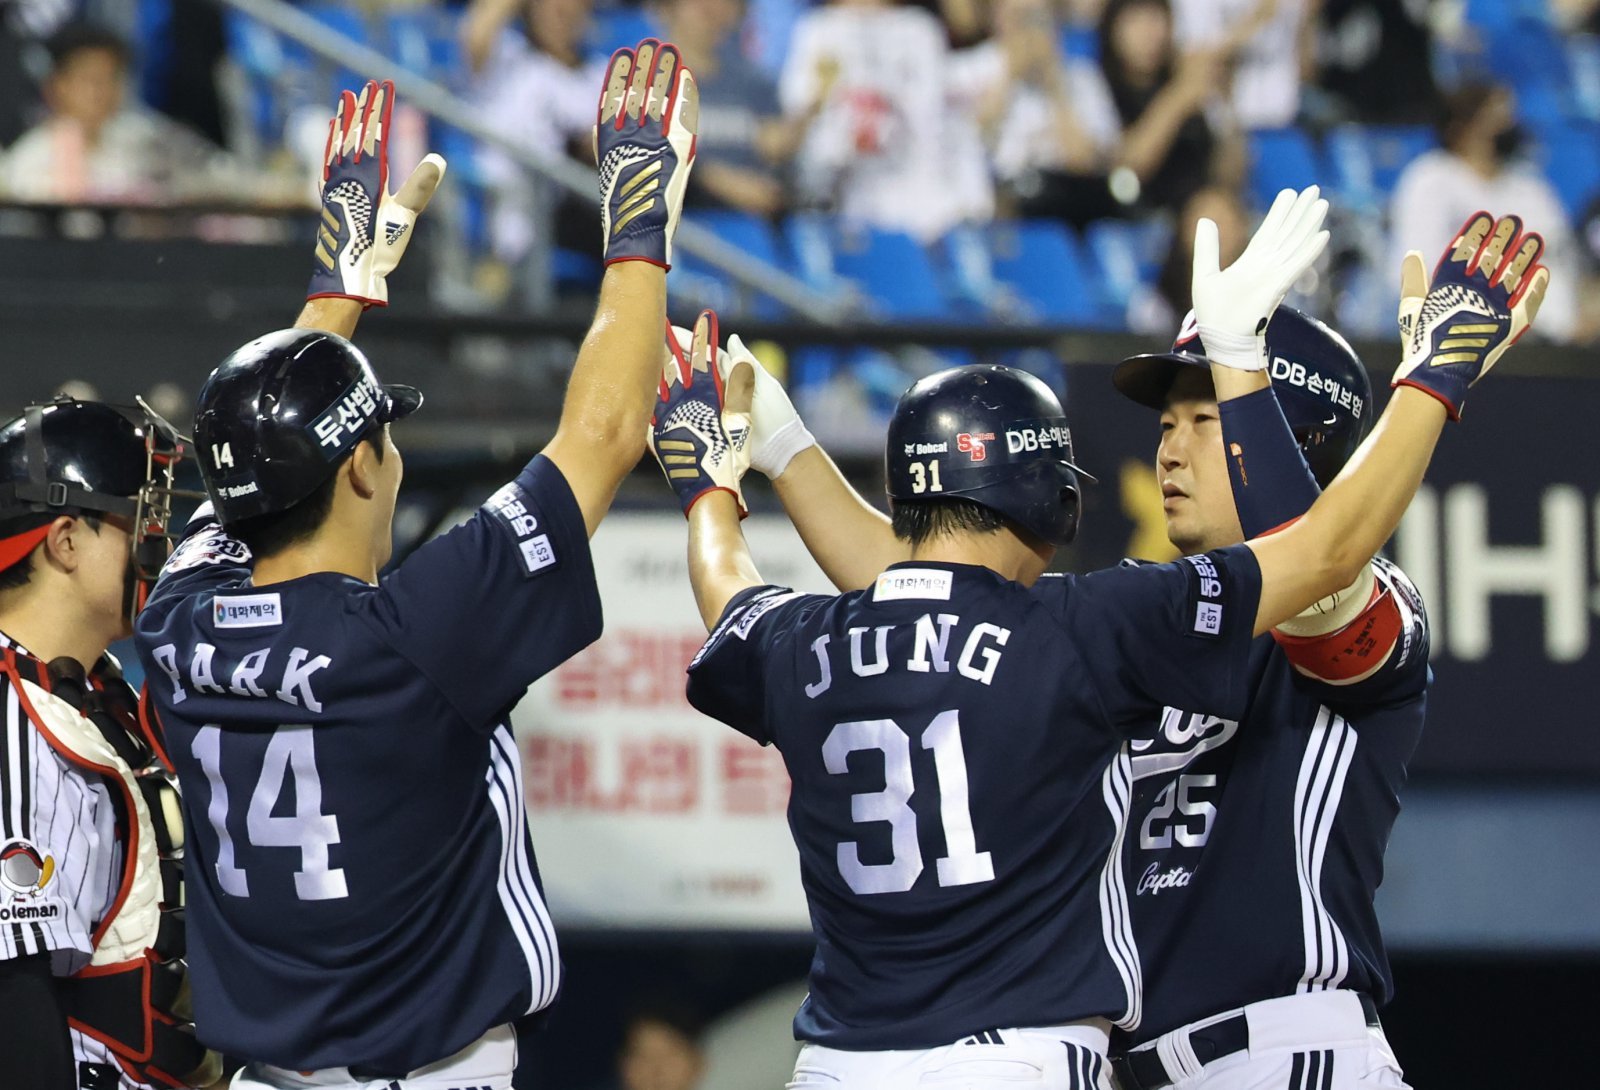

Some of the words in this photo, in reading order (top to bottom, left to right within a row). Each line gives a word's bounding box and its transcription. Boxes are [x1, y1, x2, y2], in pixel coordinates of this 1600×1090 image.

[386, 222, 409, 246] adidas
[1271, 357, 1364, 420] DB손해보험
[211, 441, 235, 470] 14
[916, 440, 950, 455] Bobcat
[1006, 427, 1073, 455] DB손해보
[228, 481, 259, 498] Bobcat
[909, 460, 942, 493] 31
[533, 541, 551, 563] EST
[227, 603, 276, 619] 대화제약
[1206, 607, 1218, 630] EST
[805, 614, 1012, 699] JUNG
[151, 642, 331, 713] PARK
[191, 725, 349, 901] 14
[822, 710, 995, 895] 31
[1139, 773, 1218, 850] 25
[1136, 861, 1194, 896] Capta
